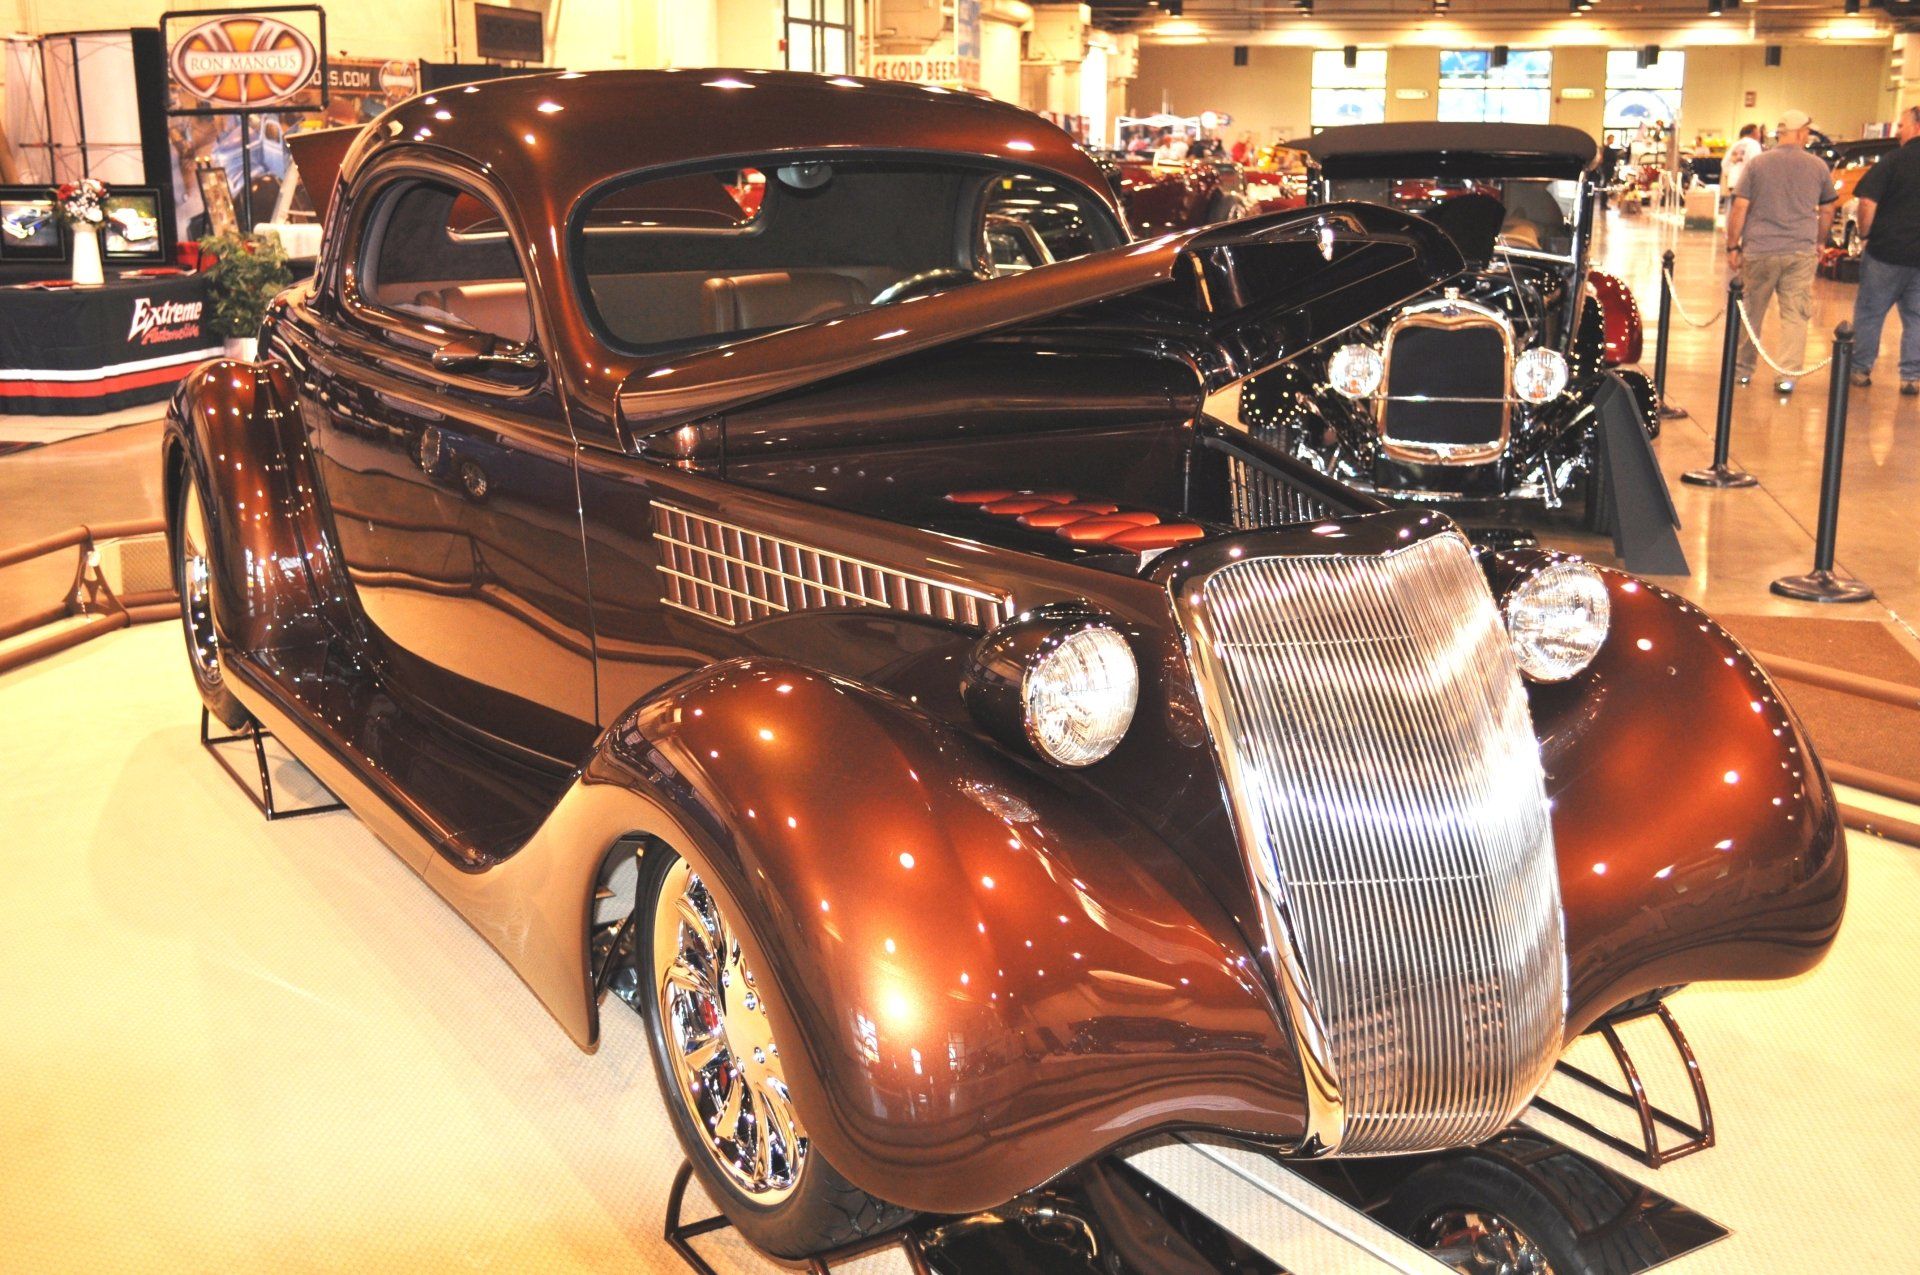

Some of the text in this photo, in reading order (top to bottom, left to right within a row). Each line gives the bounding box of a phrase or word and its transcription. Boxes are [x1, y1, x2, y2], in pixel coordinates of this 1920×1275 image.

[190, 54, 297, 71] RON MANGUS
[891, 61, 923, 81] COLD
[127, 297, 203, 342] Extreme
